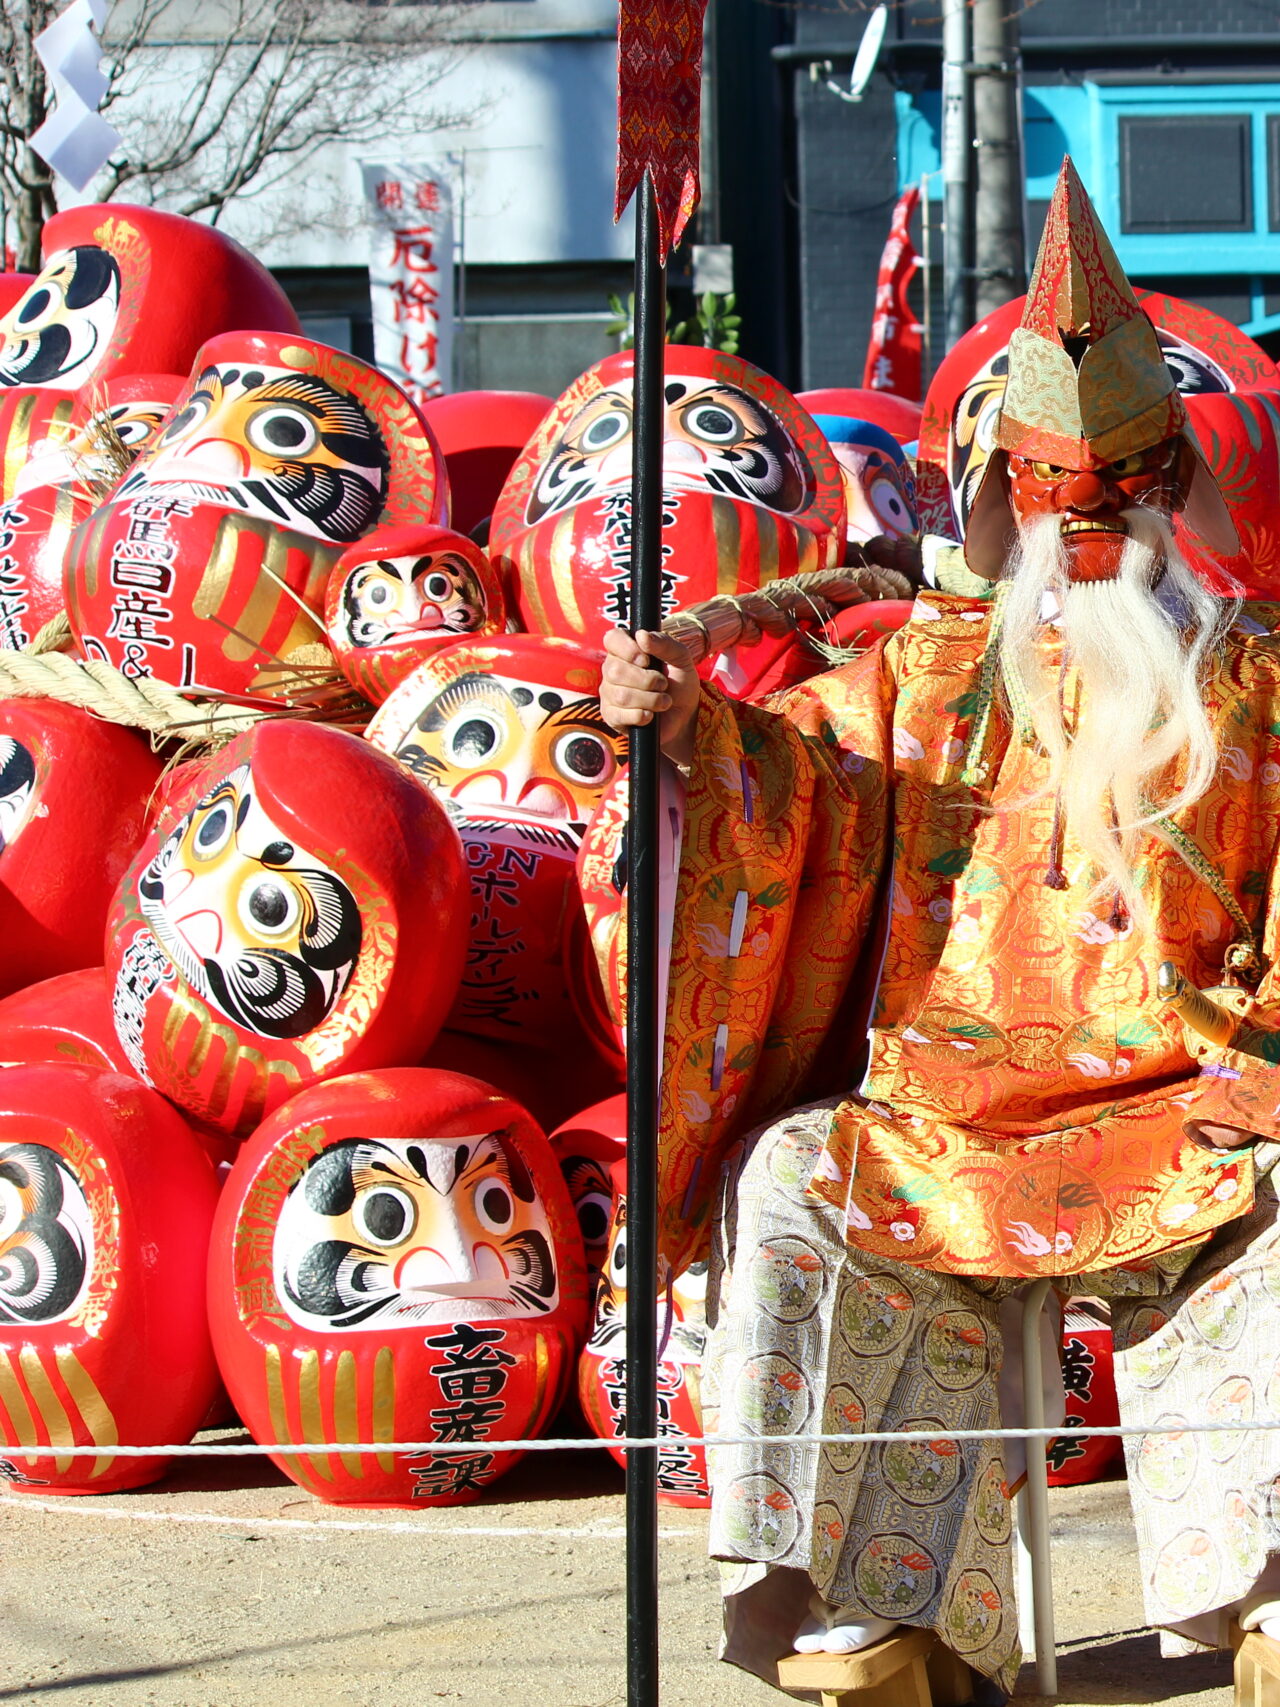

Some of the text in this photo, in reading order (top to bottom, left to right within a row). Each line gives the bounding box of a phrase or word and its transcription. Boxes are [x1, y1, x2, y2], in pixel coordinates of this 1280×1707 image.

[58, 1127, 121, 1341] 県勢発展
[398, 1322, 520, 1499] 畜産課
